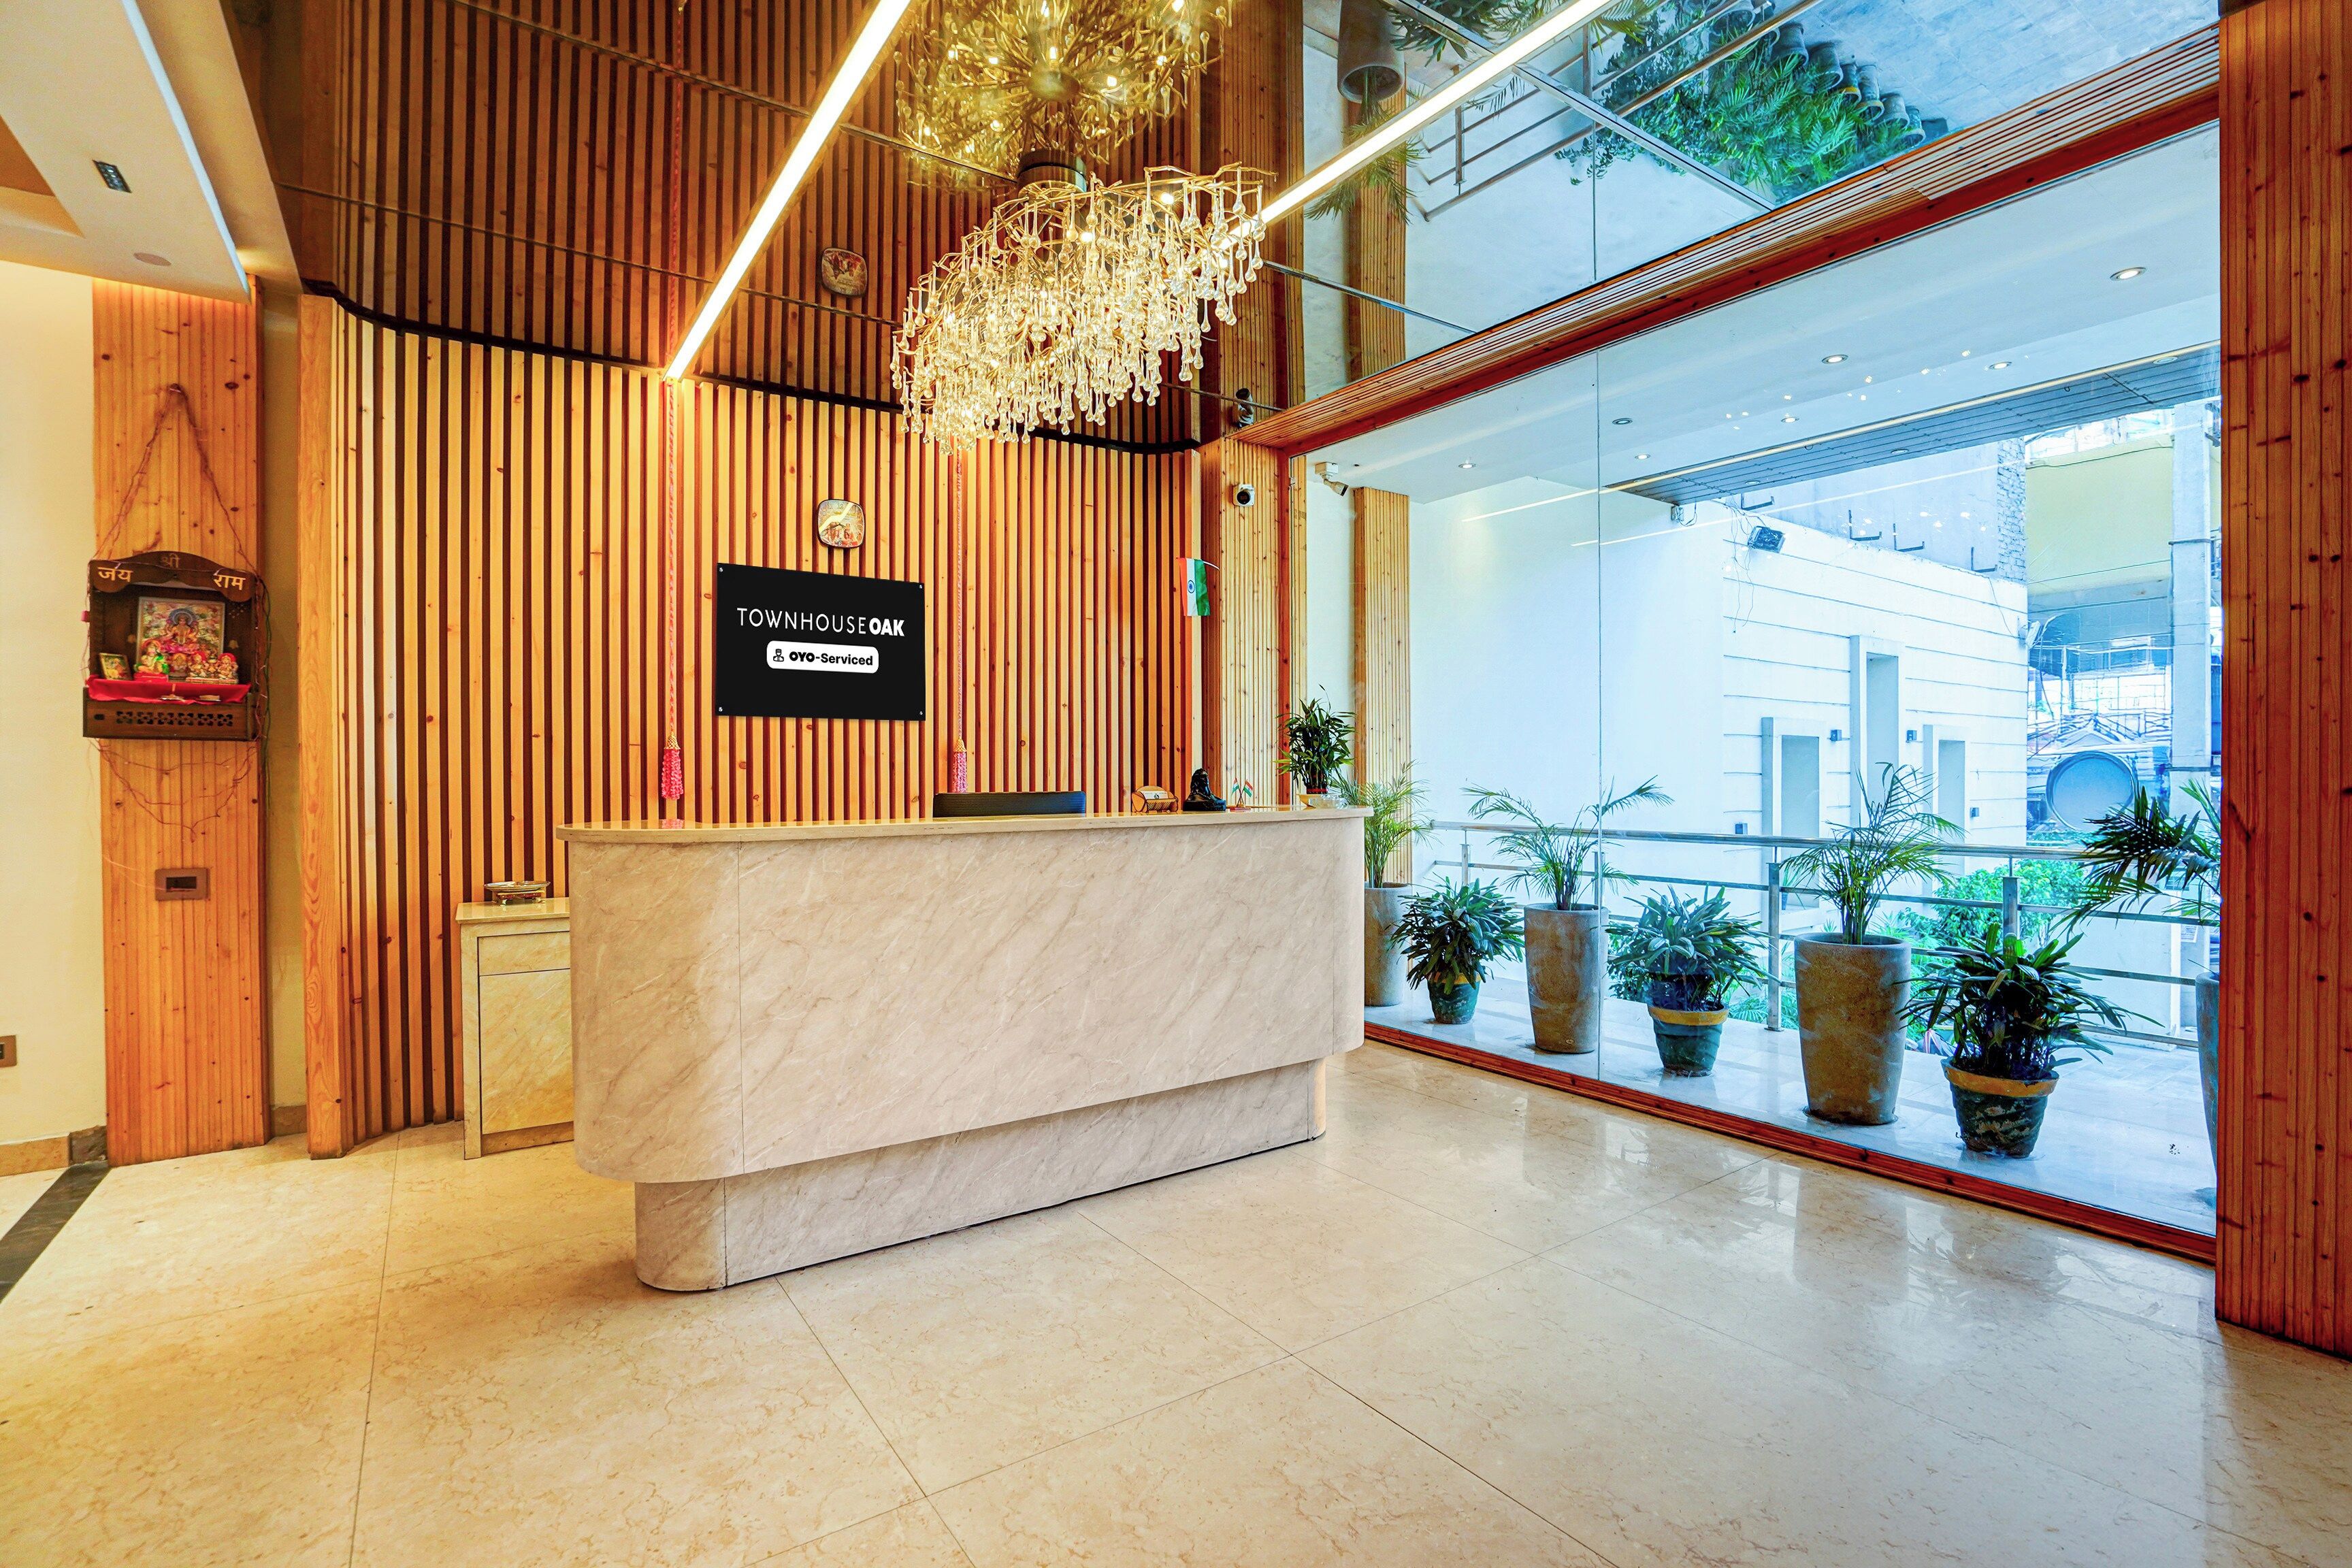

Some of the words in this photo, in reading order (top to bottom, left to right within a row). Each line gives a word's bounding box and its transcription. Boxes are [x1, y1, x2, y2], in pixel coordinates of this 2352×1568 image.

[97, 566, 133, 583] जय
[213, 573, 246, 591] राम
[789, 651, 873, 666] OYO-Serviced
